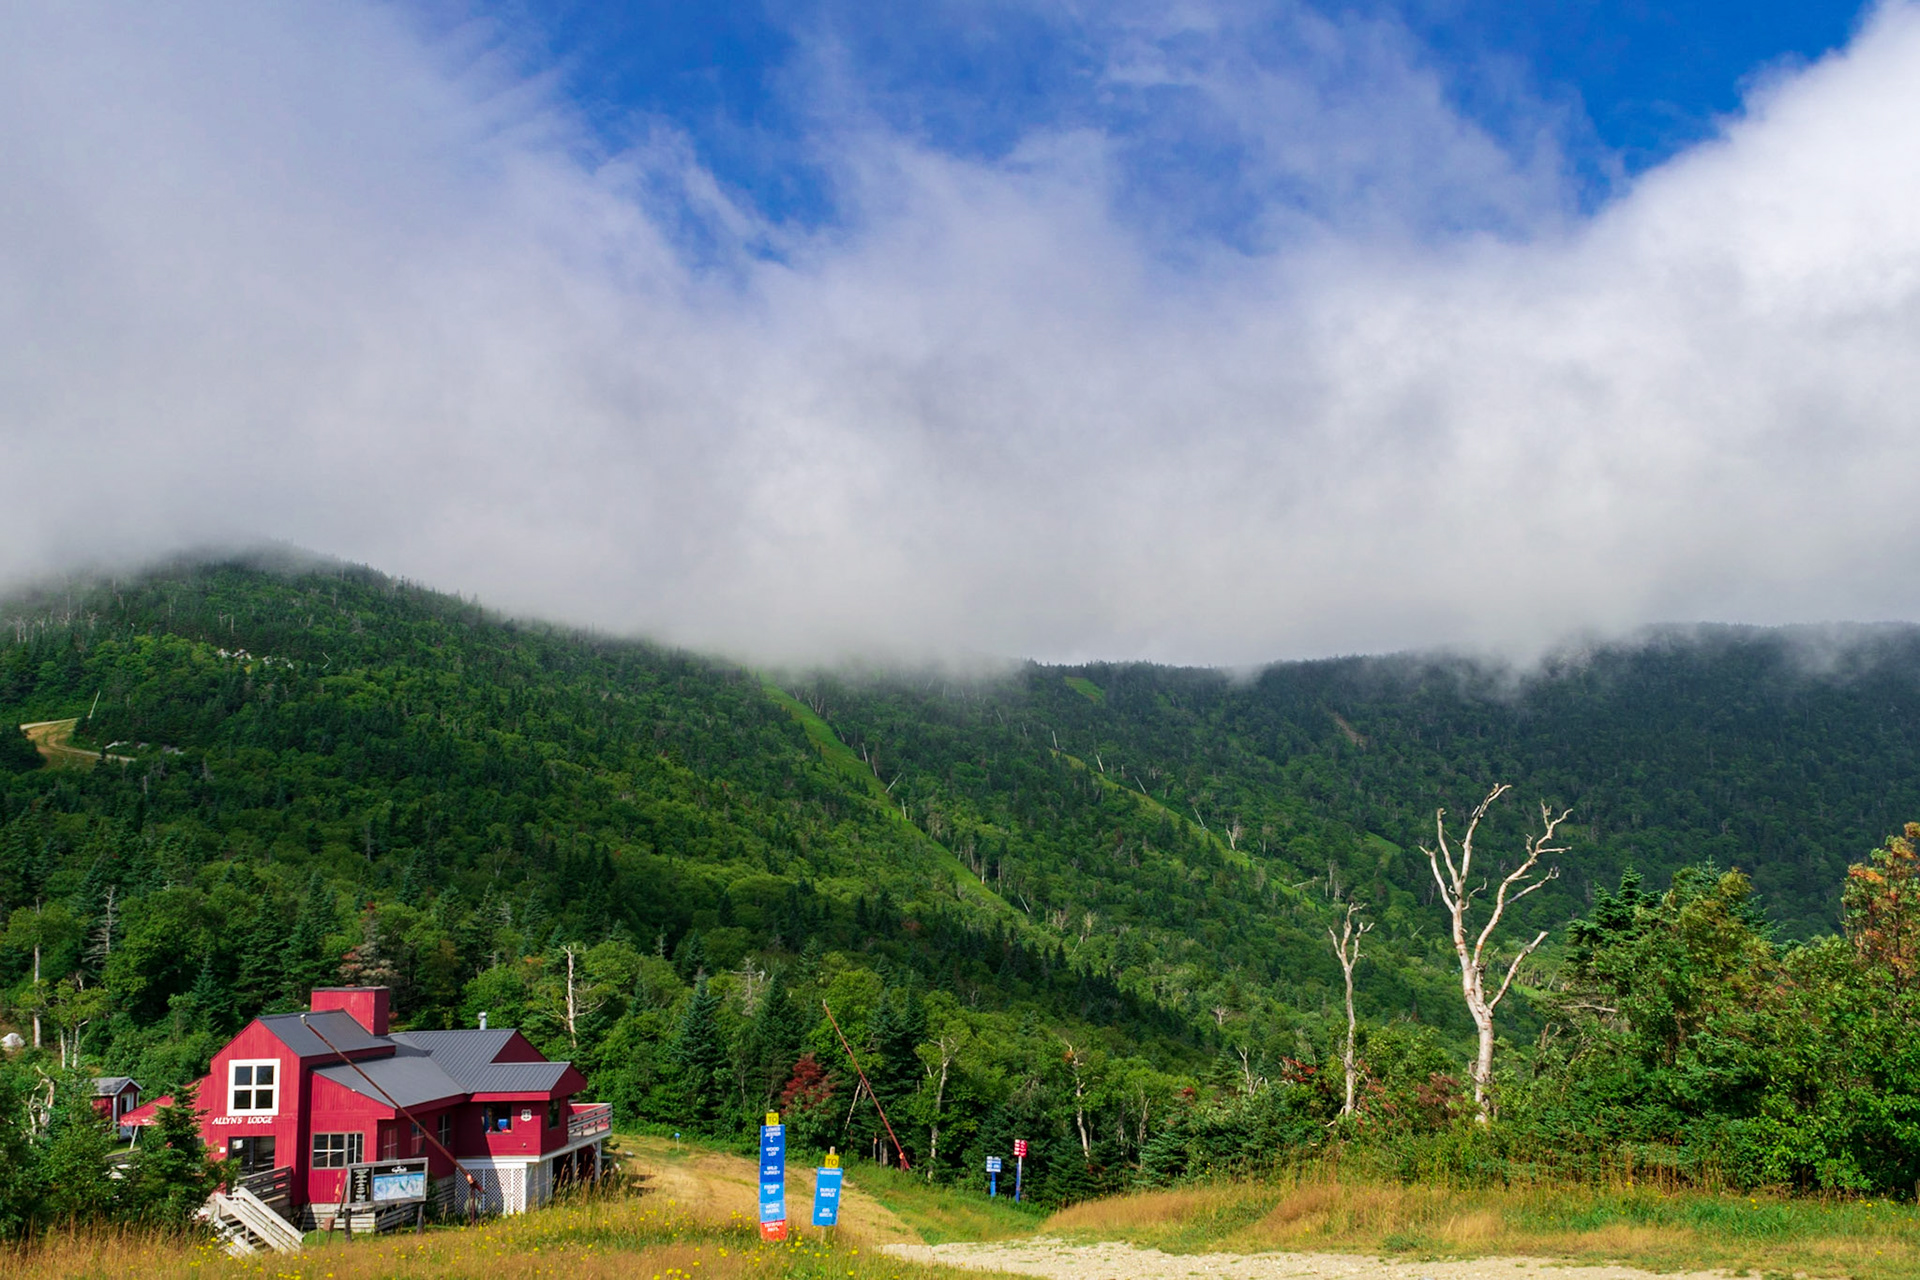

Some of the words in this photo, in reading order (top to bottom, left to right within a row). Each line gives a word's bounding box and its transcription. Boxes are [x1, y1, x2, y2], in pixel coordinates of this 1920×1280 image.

[211, 1116, 243, 1125] ALLYN'S
[247, 1116, 273, 1124] LODGE
[827, 1158, 838, 1166] TO
